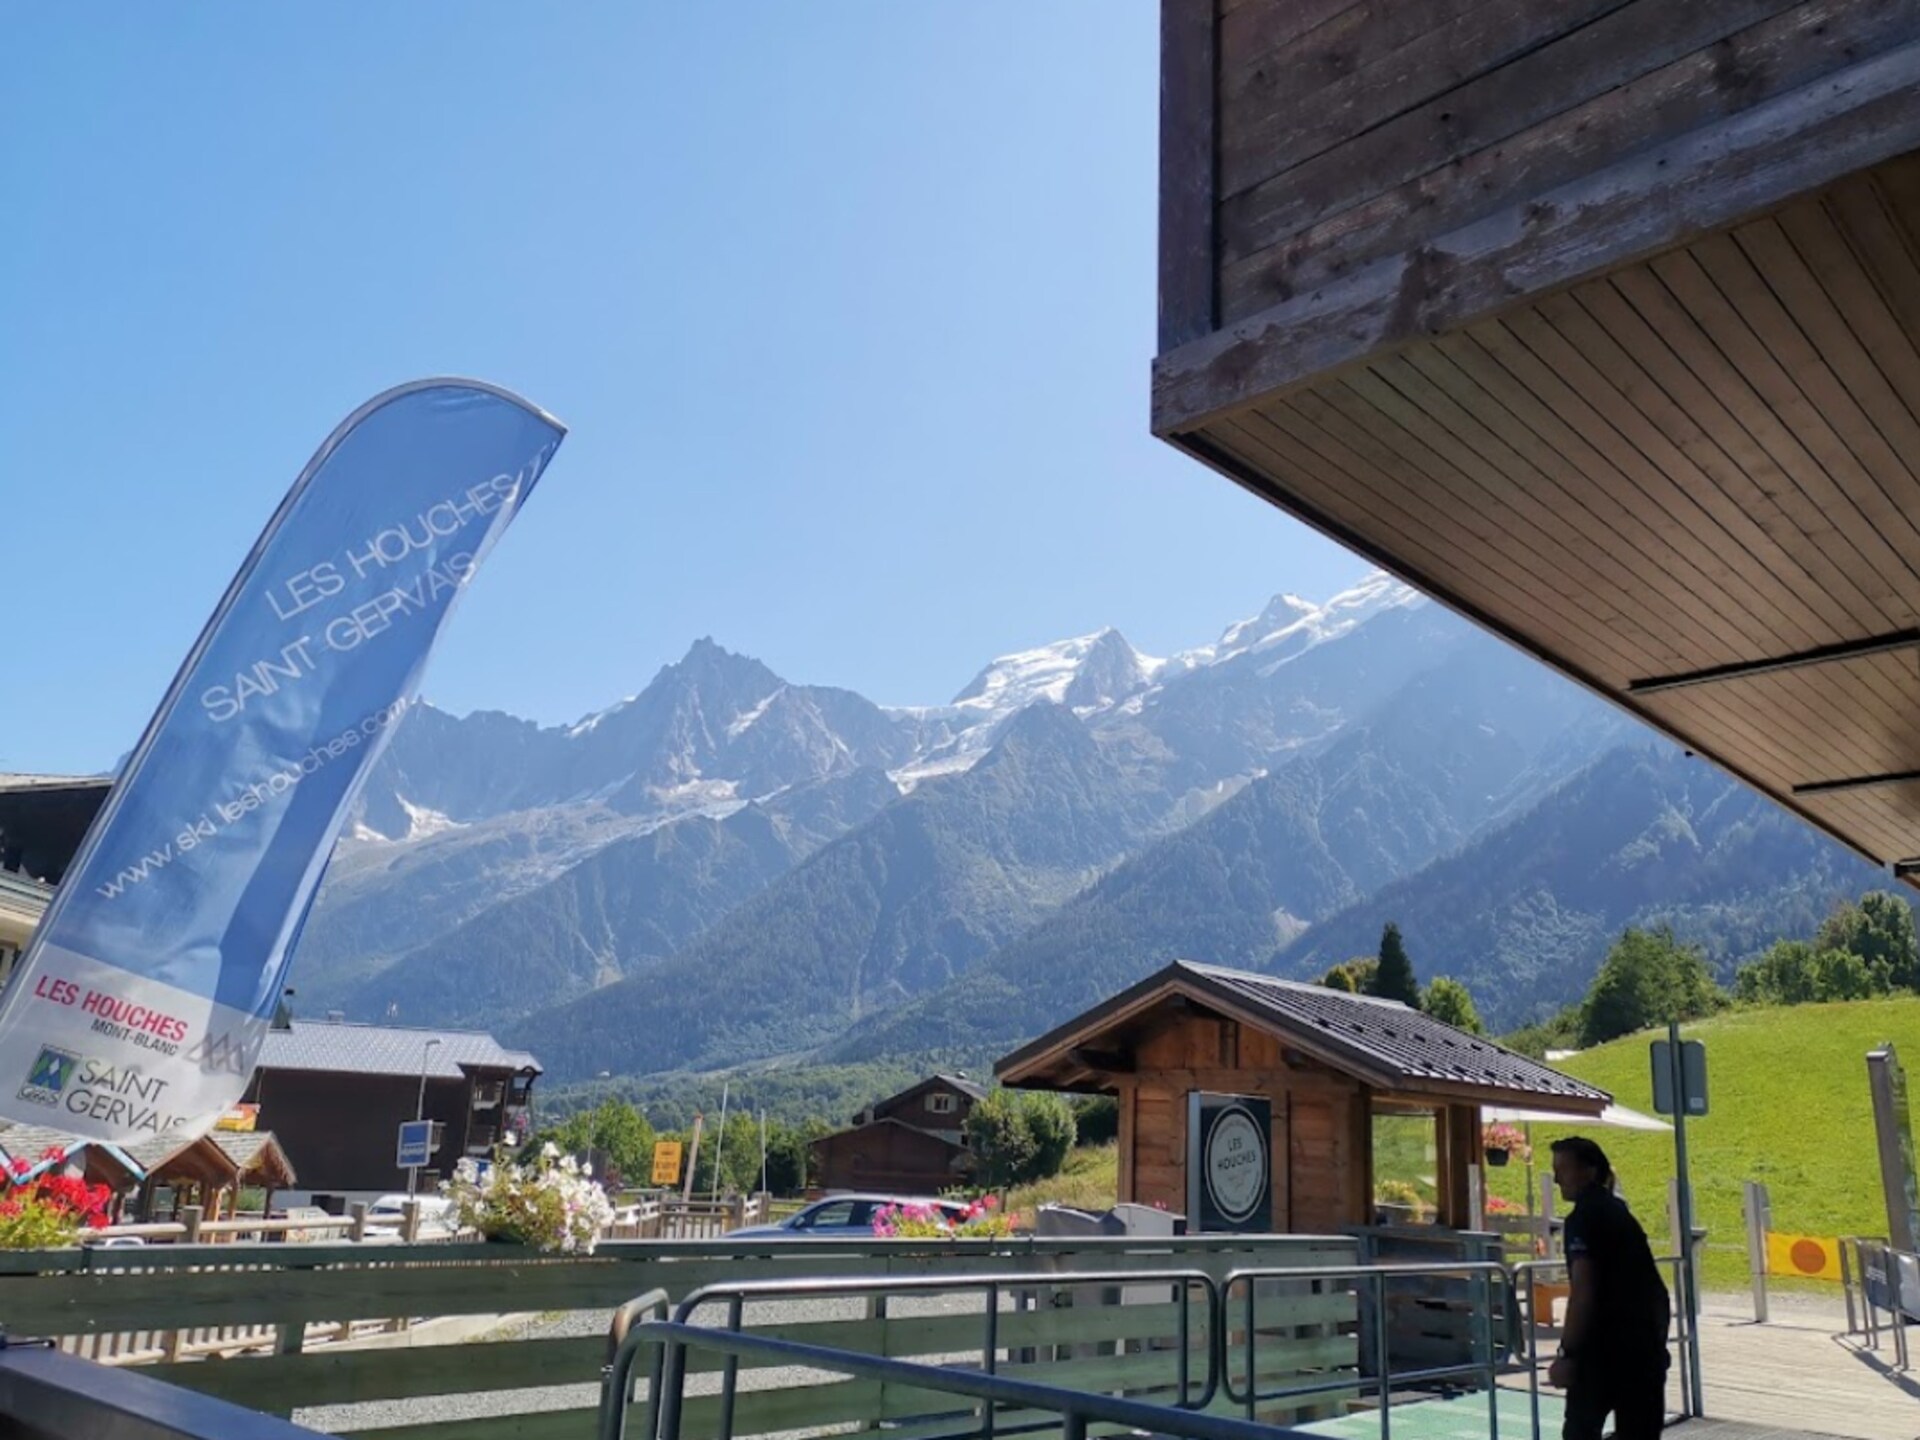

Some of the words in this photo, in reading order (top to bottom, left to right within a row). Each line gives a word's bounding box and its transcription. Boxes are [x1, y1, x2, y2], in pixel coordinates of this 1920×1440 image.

[264, 562, 345, 621] LES
[346, 473, 516, 578] HOUCHES
[200, 634, 316, 722] SAINT
[325, 551, 476, 651] GERVAIS
[96, 697, 406, 899] www.skileshouches.com
[34, 975, 80, 1006] LES
[81, 990, 189, 1042] HOUCHES
[90, 1018, 179, 1056] MONT-BLANC
[79, 1060, 169, 1102] SAINT
[1217, 1150, 1256, 1170] HOUCHES
[1227, 1137, 1242, 1152] LES
